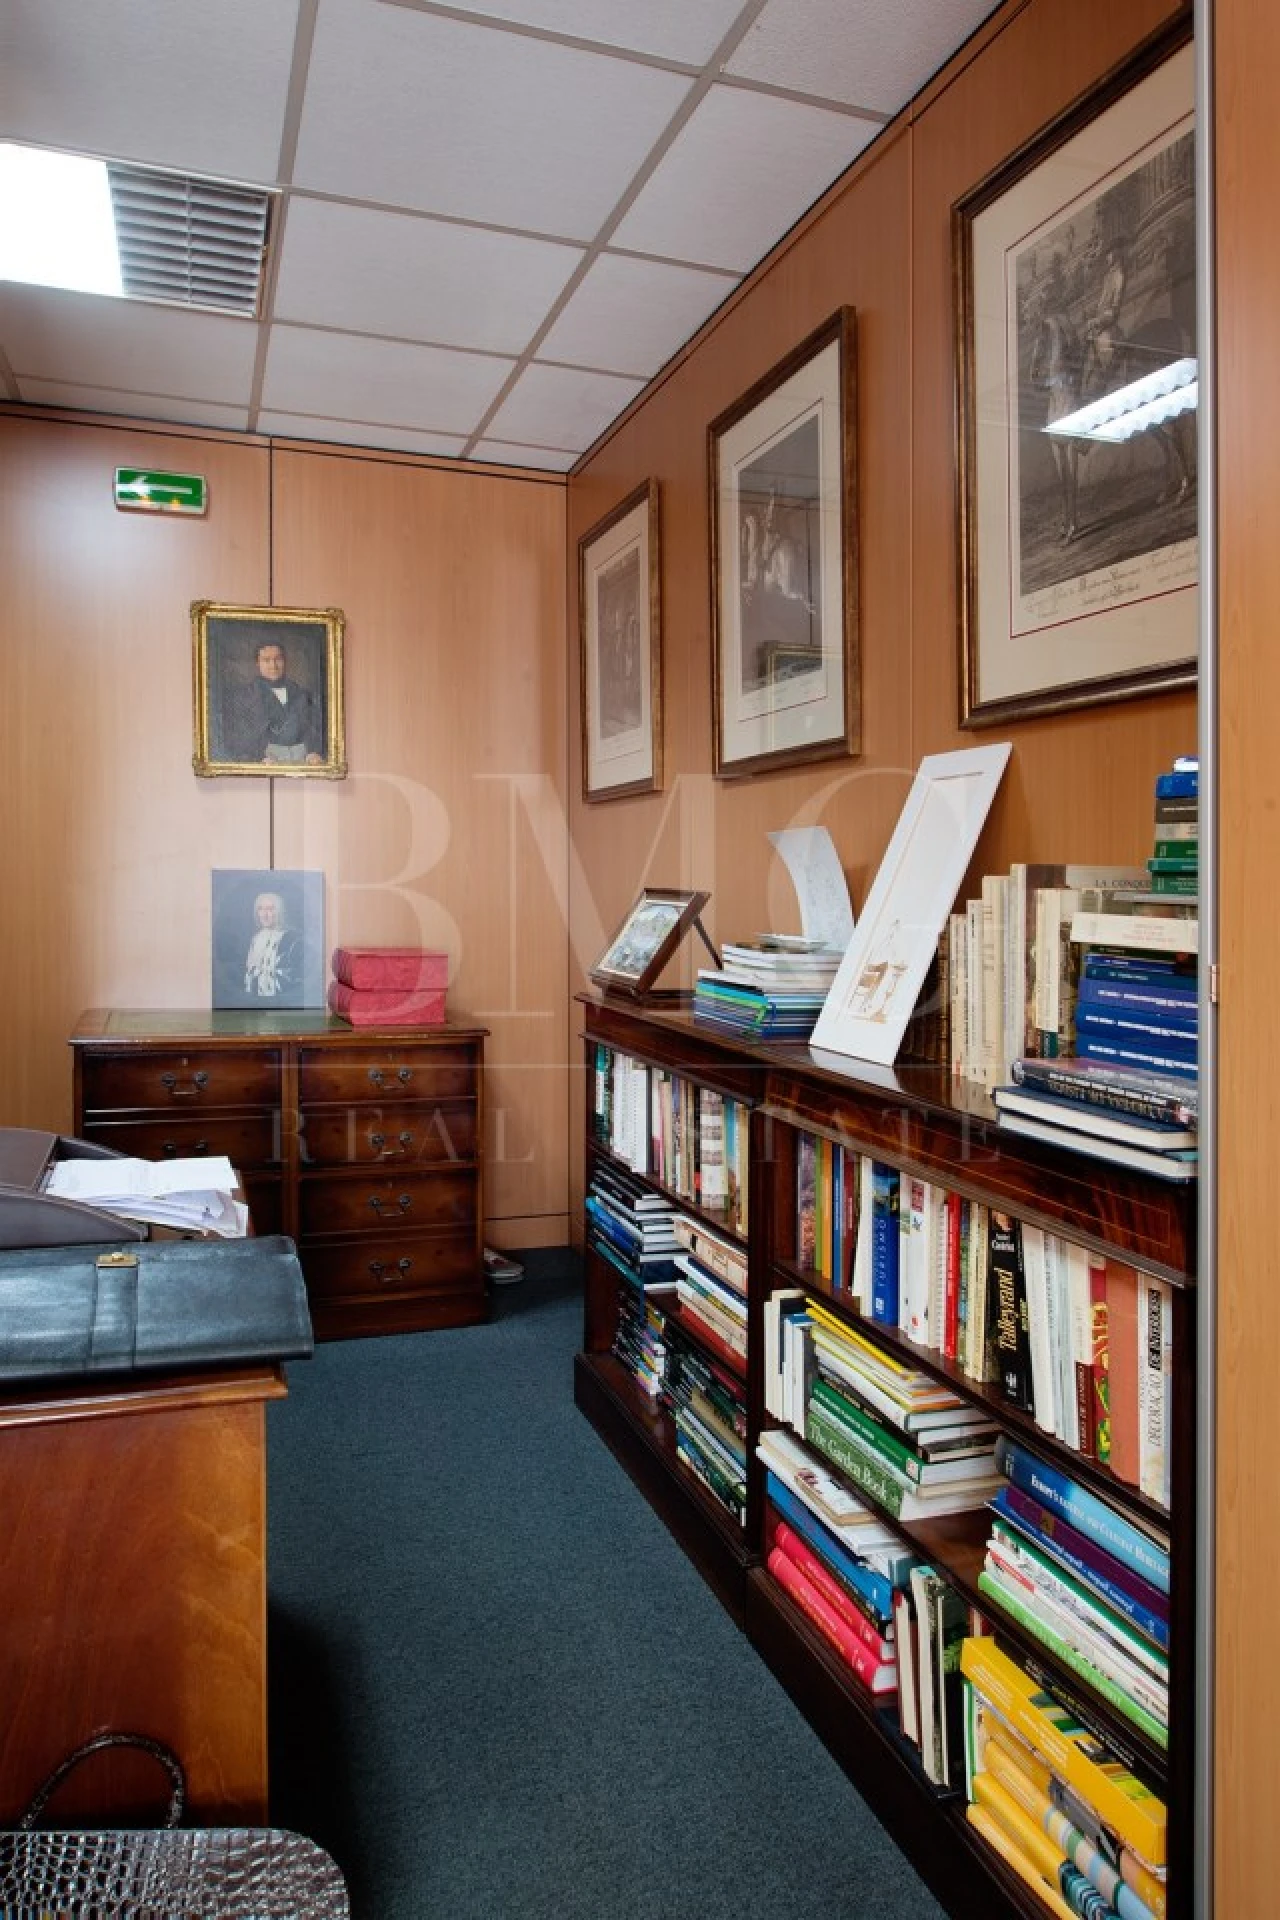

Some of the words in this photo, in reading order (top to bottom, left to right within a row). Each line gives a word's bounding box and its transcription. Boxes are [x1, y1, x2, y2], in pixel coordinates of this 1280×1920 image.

[994, 1266, 1019, 1351] Talleyrand
[810, 1421, 826, 1447] The
[827, 1439, 861, 1479] Garden
[862, 1465, 887, 1502] Book
